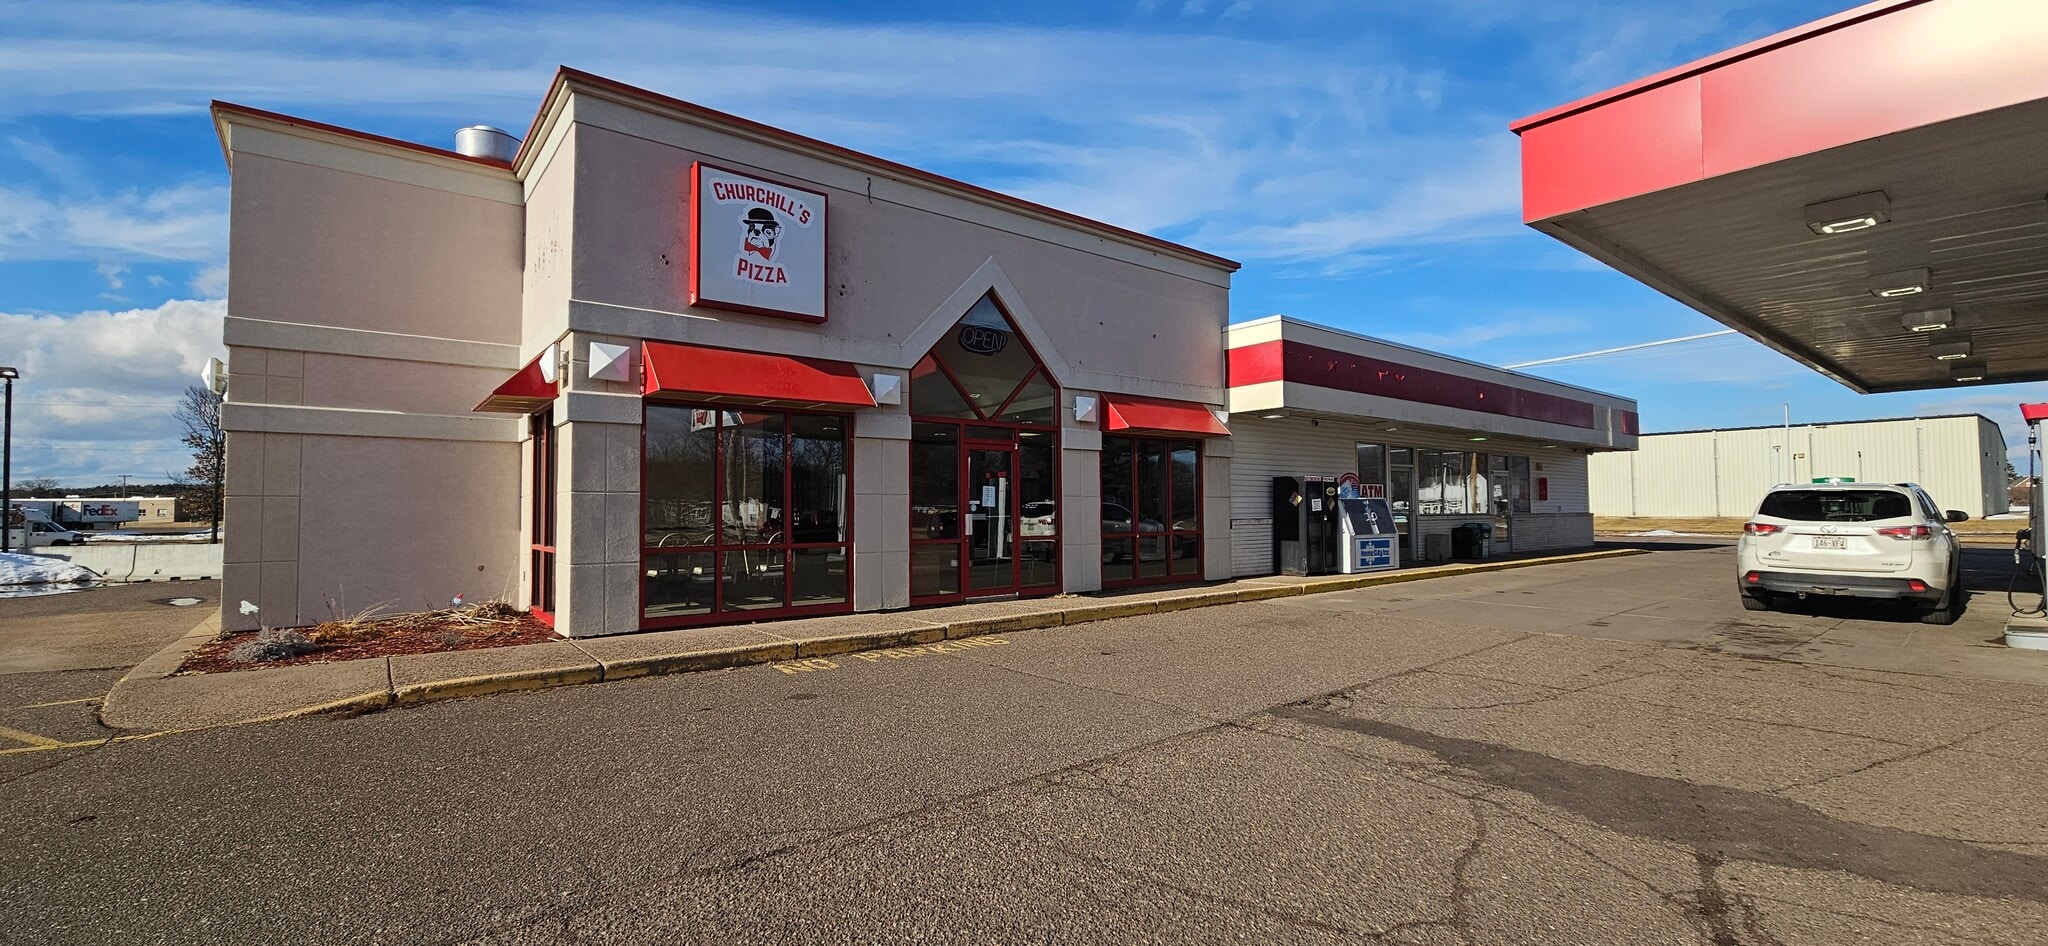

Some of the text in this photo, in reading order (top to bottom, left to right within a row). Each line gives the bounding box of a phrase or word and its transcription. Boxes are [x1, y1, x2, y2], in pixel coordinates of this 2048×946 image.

[713, 182, 811, 224] CHURCHILL'S
[737, 258, 787, 283] PIZZA
[963, 327, 1003, 350] OPEN
[1361, 485, 1383, 498] ATM
[83, 504, 118, 516] FedEx
[772, 658, 840, 675] NO
